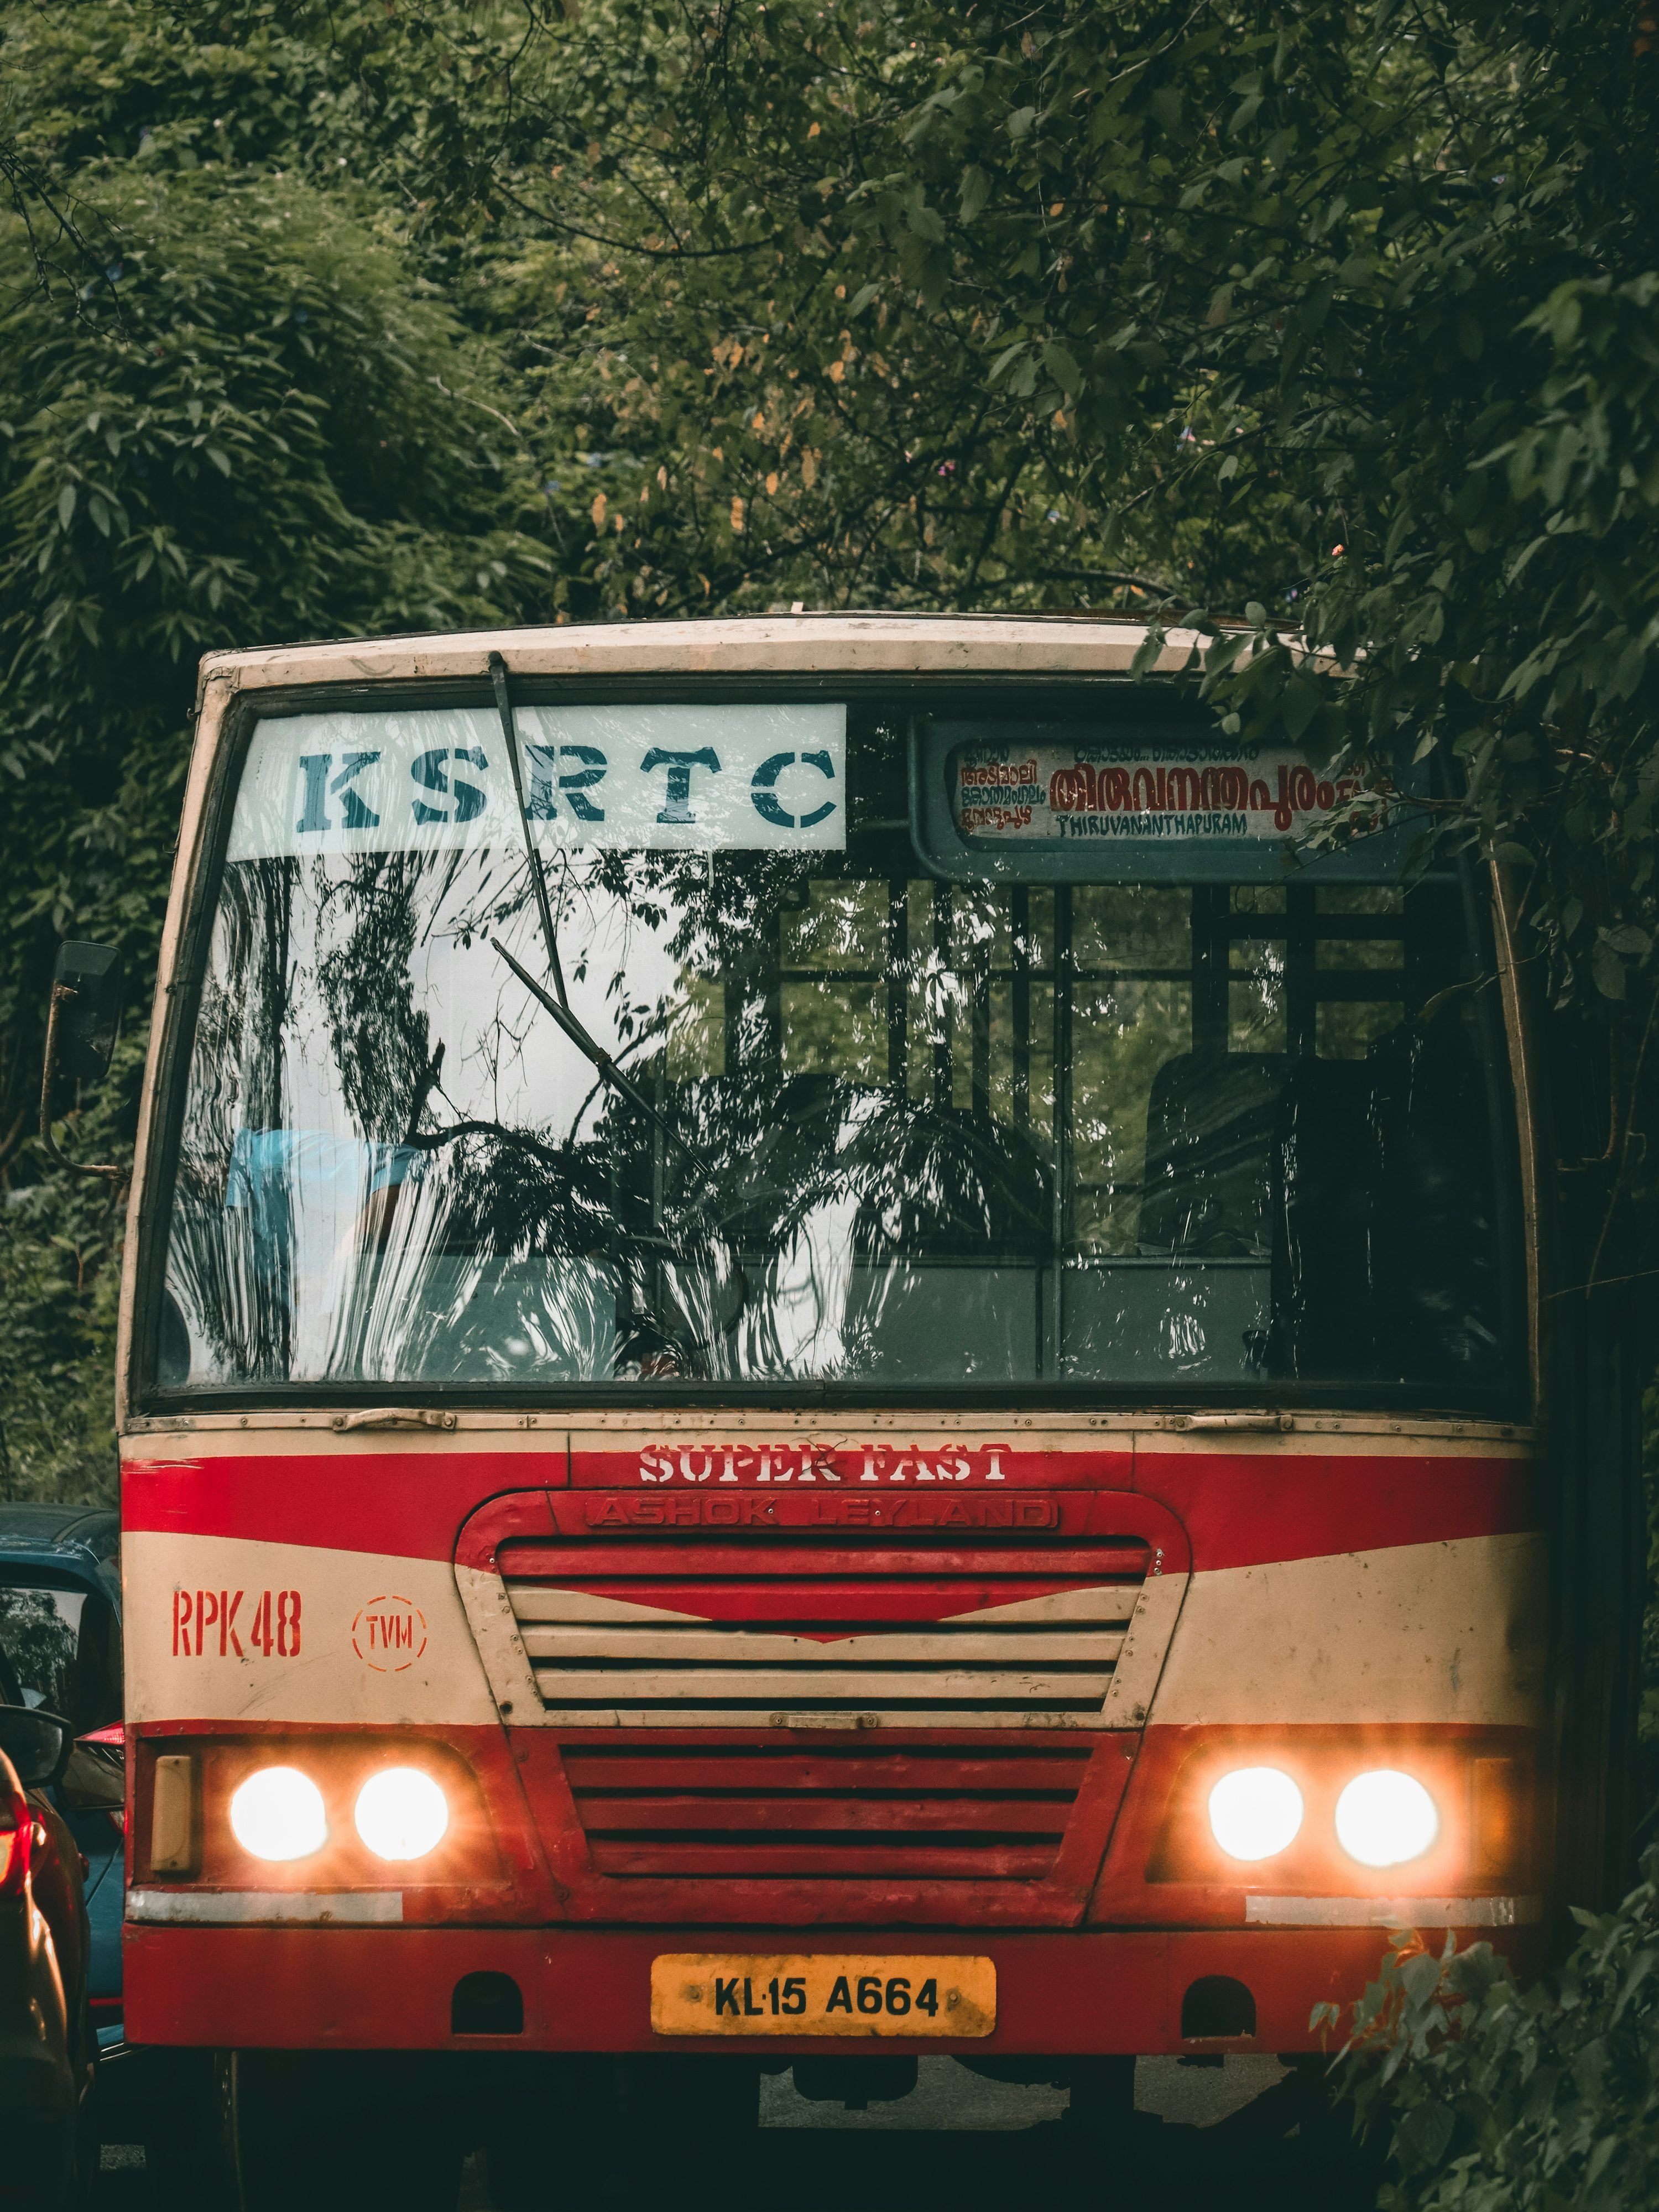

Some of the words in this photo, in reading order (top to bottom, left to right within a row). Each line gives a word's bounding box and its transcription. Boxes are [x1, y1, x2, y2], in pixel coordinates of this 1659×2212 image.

[296, 745, 837, 833] KSRTC
[1050, 763, 1335, 831] തിരുവനന്തപുരം
[1056, 813, 1248, 837] THIRUVANANTHAPURAM
[639, 1443, 842, 1482] SUPER
[860, 1443, 1012, 1481] FAST
[593, 1498, 776, 1525] ASHOK
[811, 1498, 1055, 1527] LEYLAND
[366, 1615, 413, 1650] TVM
[825, 1975, 939, 2017] A664
